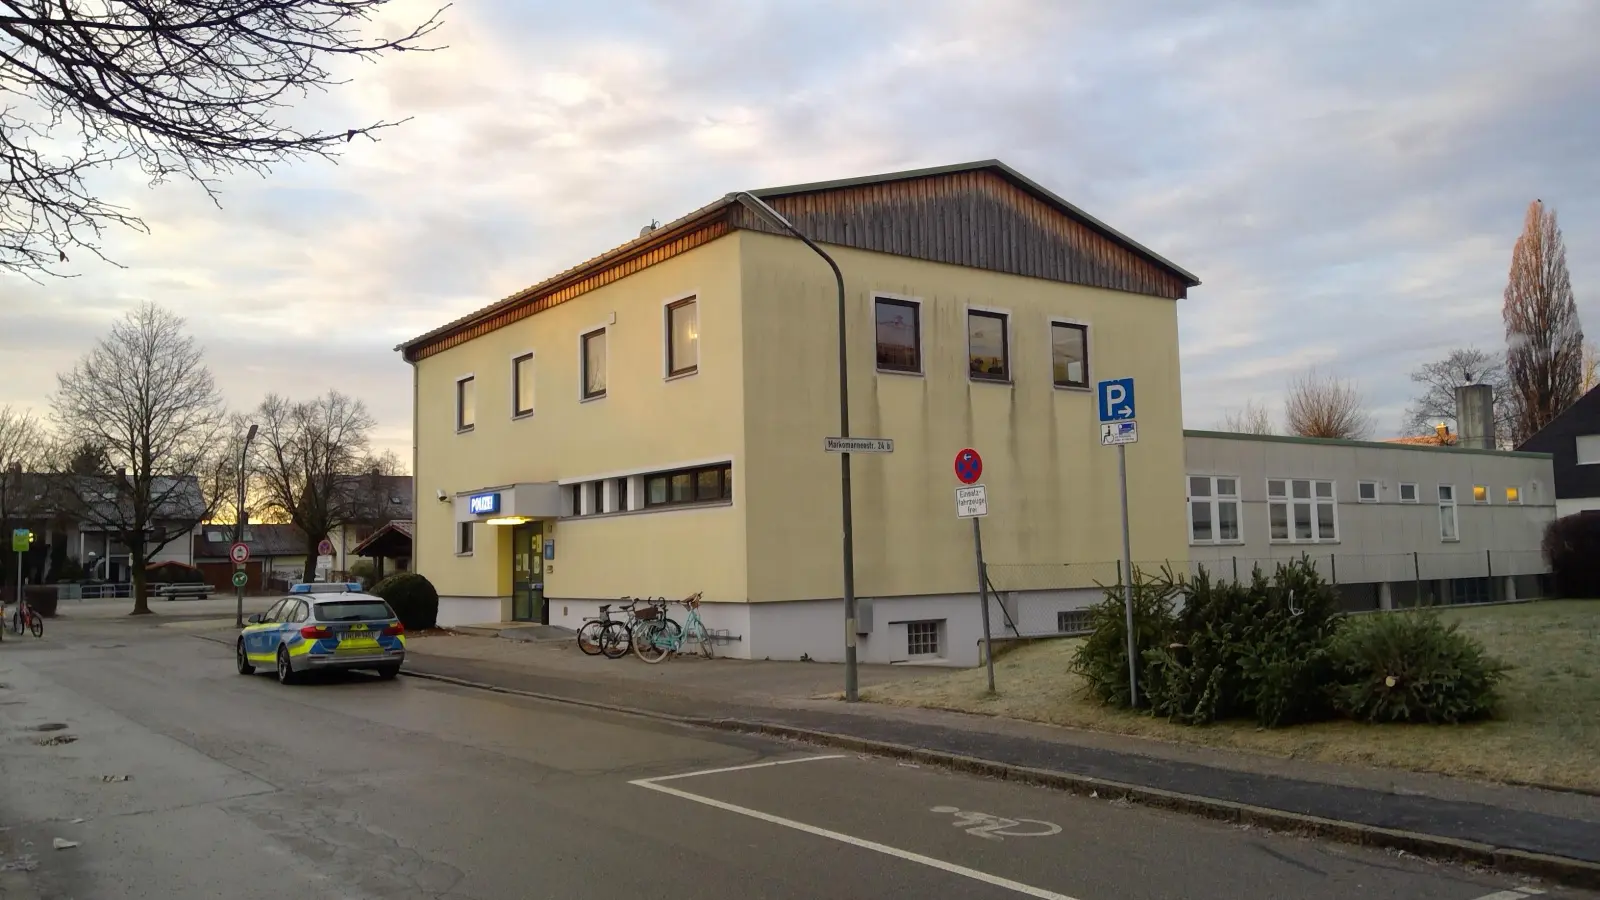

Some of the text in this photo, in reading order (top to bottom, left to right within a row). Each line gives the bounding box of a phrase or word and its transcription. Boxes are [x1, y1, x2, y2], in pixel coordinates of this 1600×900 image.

[1107, 385, 1126, 416] P
[877, 442, 885, 450] 24
[886, 442, 891, 450] b
[471, 495, 493, 513] POLIZEI
[967, 506, 978, 514] frei
